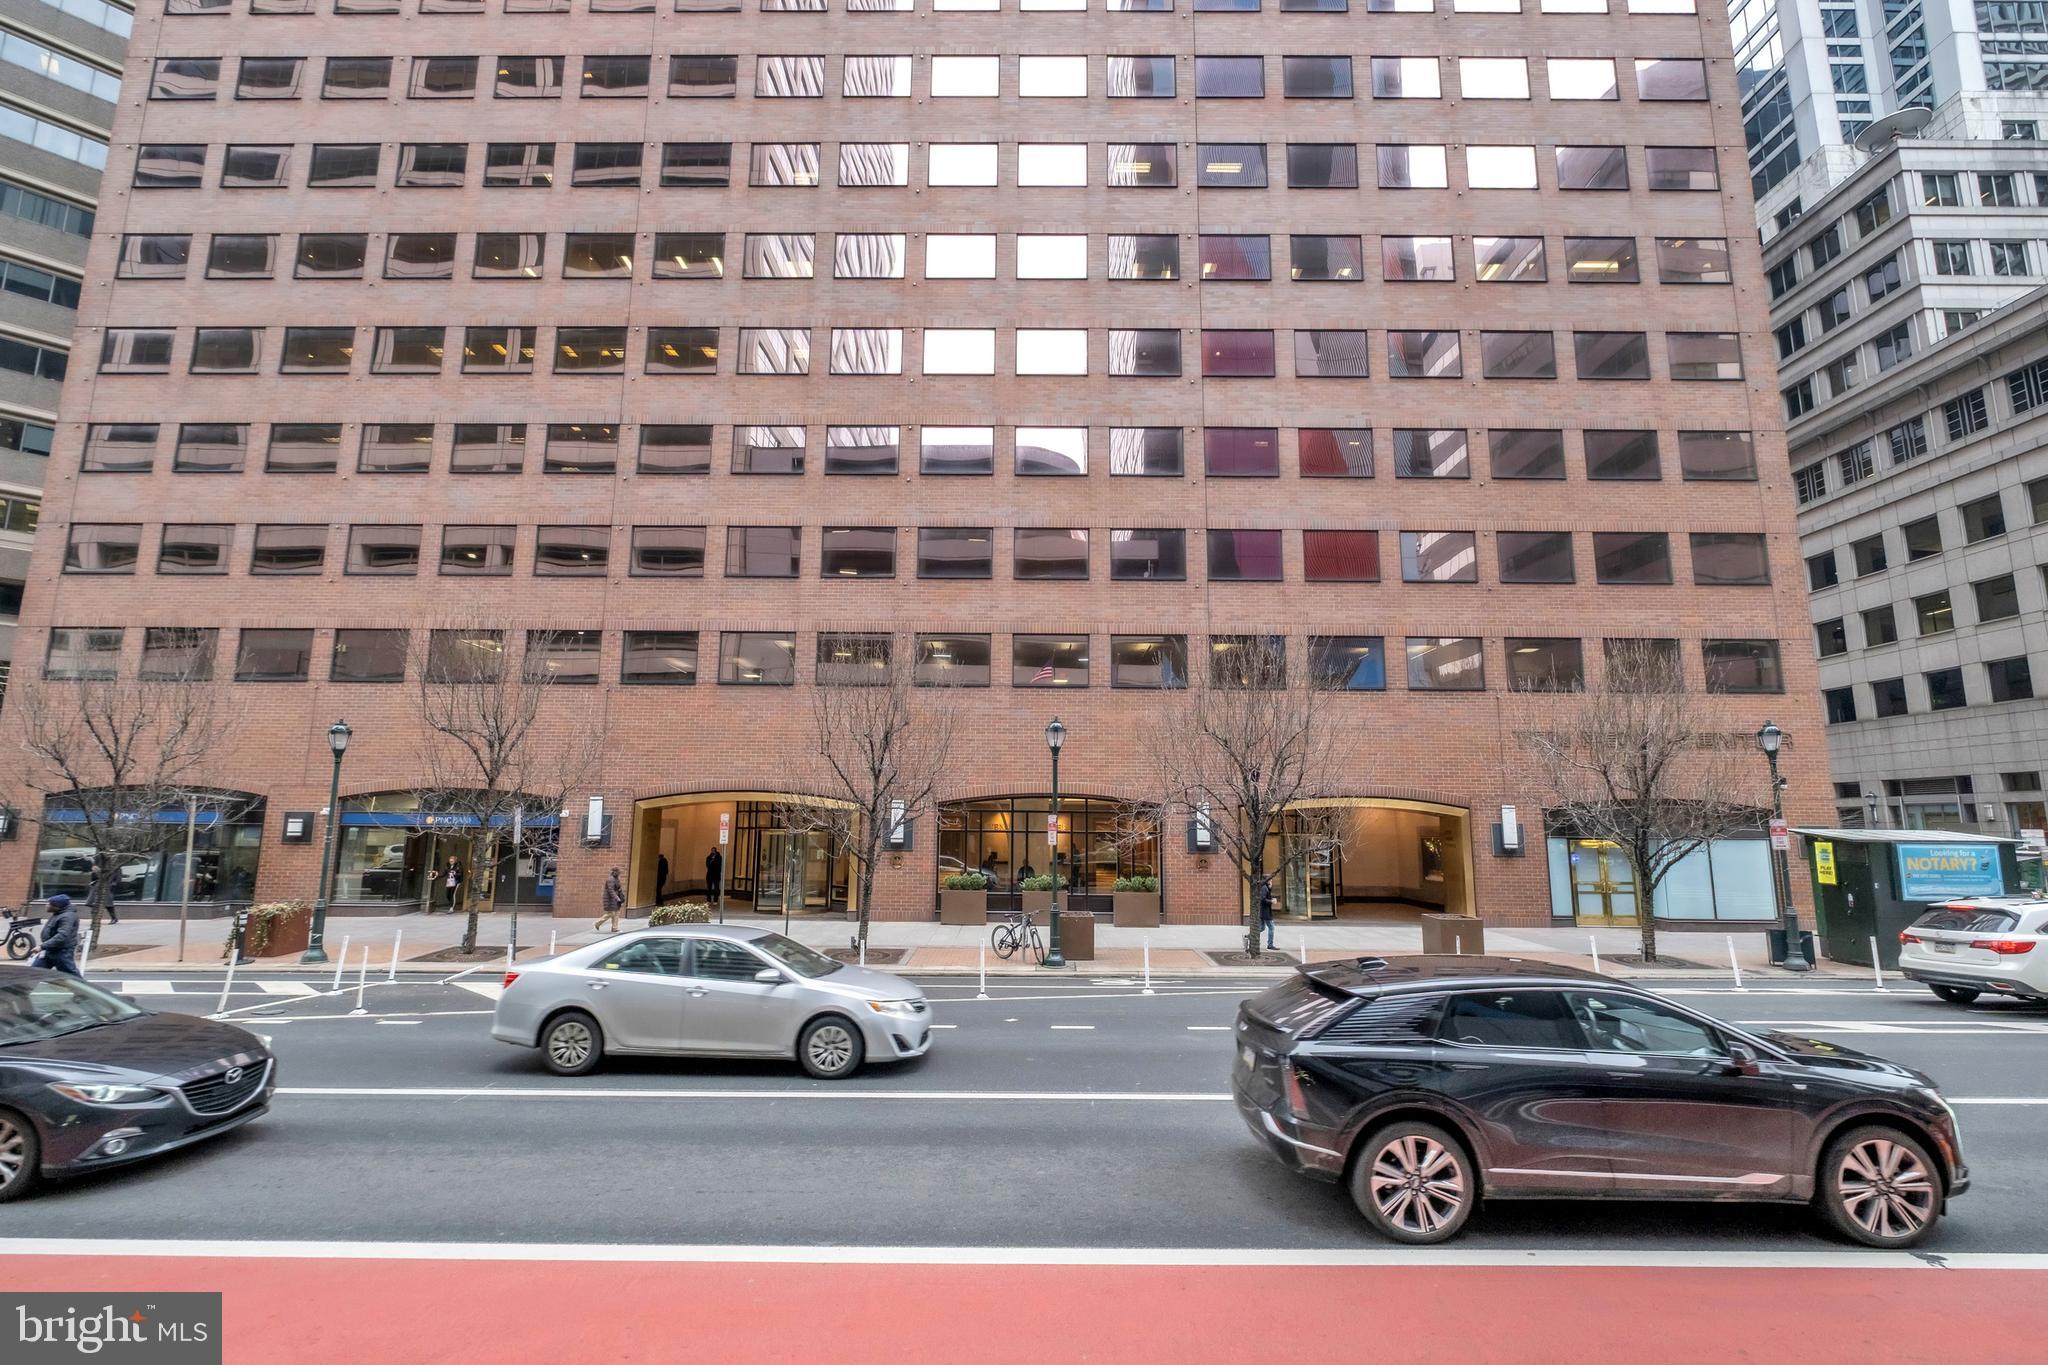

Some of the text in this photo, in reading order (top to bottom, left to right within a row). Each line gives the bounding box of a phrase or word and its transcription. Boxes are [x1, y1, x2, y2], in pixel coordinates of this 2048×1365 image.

[435, 816, 451, 824] PNC
[1930, 849, 1958, 857] Looking
[1907, 857, 1977, 871] NOTARY?
